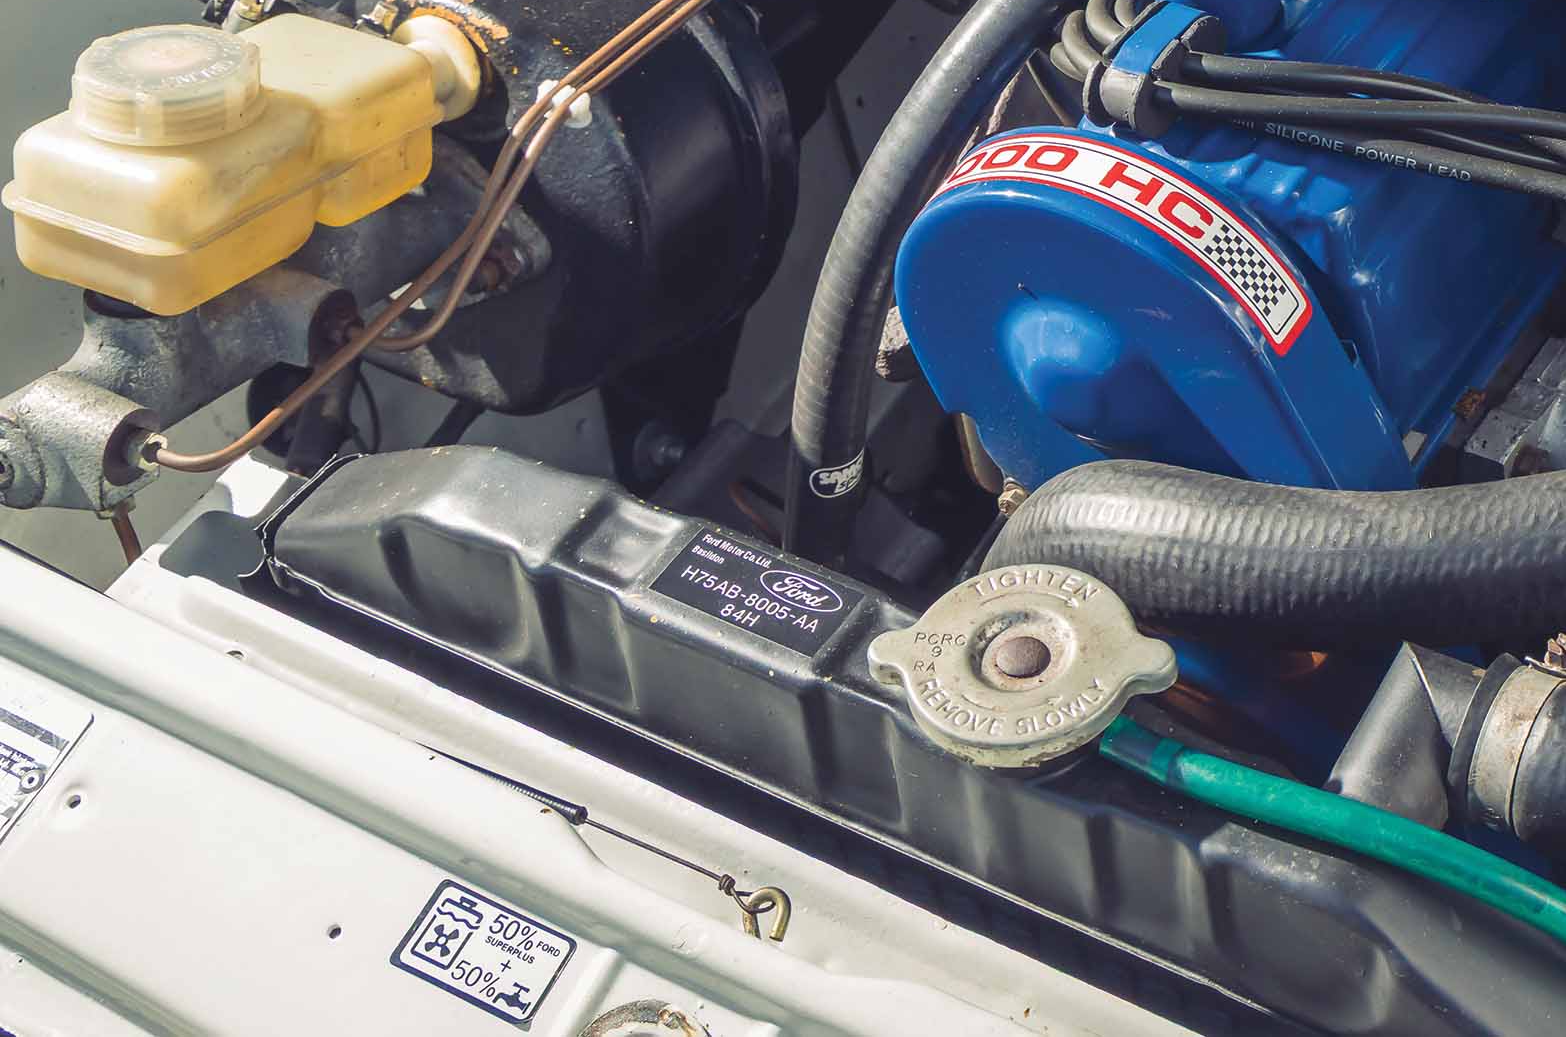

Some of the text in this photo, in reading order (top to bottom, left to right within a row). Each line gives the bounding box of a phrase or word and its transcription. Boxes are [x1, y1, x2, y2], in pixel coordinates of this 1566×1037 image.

[1264, 121, 1344, 153] SILICONE
[1353, 146, 1417, 170] POWER
[1099, 160, 1214, 240] HC
[692, 544, 724, 565] Basildon
[702, 533, 722, 548] Ford
[720, 541, 745, 559] Motor
[681, 565, 819, 633] H75AB-8005-AA
[771, 575, 830, 608] Ford
[967, 569, 1101, 603] TIGHTEN
[720, 603, 760, 627] 84H
[913, 660, 936, 673] RA
[931, 645, 942, 658] 9
[919, 677, 1108, 737] REMOVE SLOWLY
[485, 935, 535, 964] SUPERPLUS
[489, 914, 560, 958] 50% FORD
[451, 960, 500, 998] 50%
